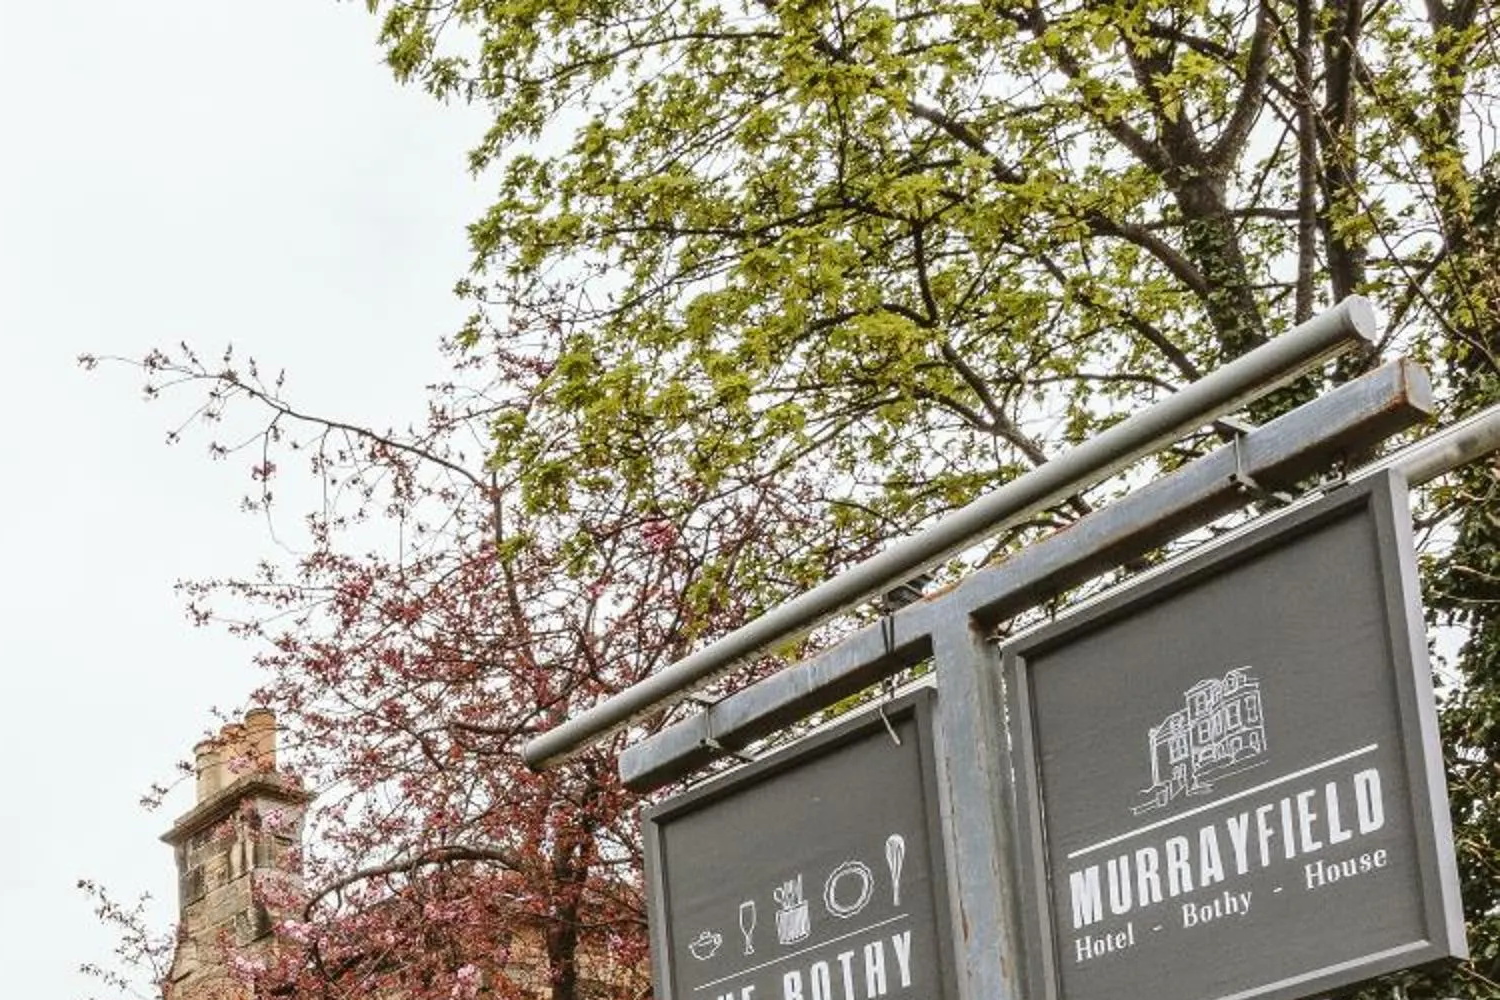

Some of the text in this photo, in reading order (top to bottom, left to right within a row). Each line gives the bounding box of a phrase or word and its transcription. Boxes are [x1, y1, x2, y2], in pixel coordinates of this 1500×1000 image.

[1069, 768, 1385, 929] MURRAYFIELD
[1075, 922, 1135, 962] Hotel
[1181, 891, 1252, 929] Bothy
[1304, 849, 1387, 890] House
